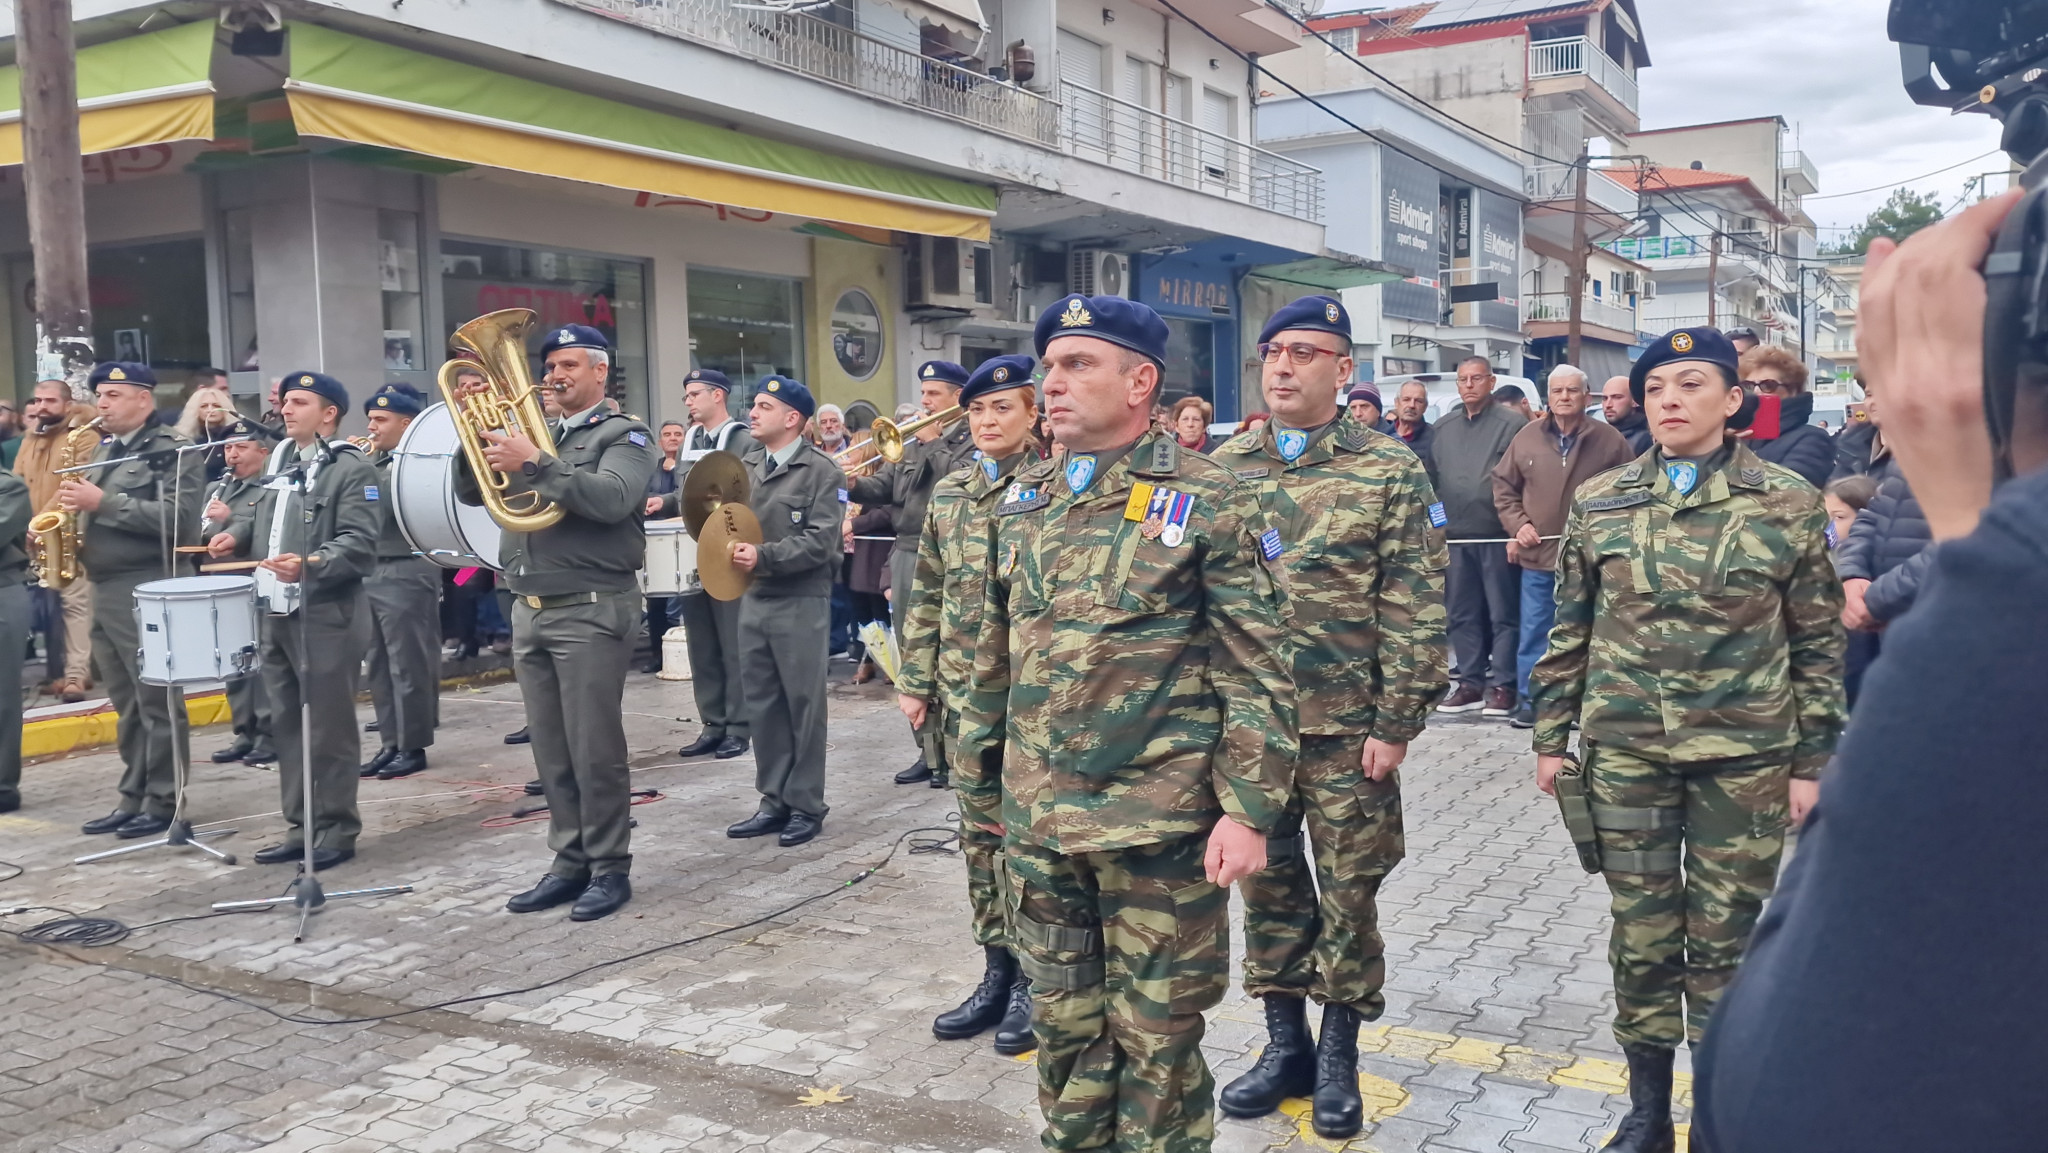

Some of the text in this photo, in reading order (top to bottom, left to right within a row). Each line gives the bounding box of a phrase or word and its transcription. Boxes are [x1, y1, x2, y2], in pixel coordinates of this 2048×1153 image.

[1400, 201, 1433, 234] Admiral
[1459, 199, 1468, 235] Admiral
[1397, 233, 1427, 251] sport shops
[1492, 234, 1516, 260] Admiral
[1160, 277, 1227, 308] MIRROR
